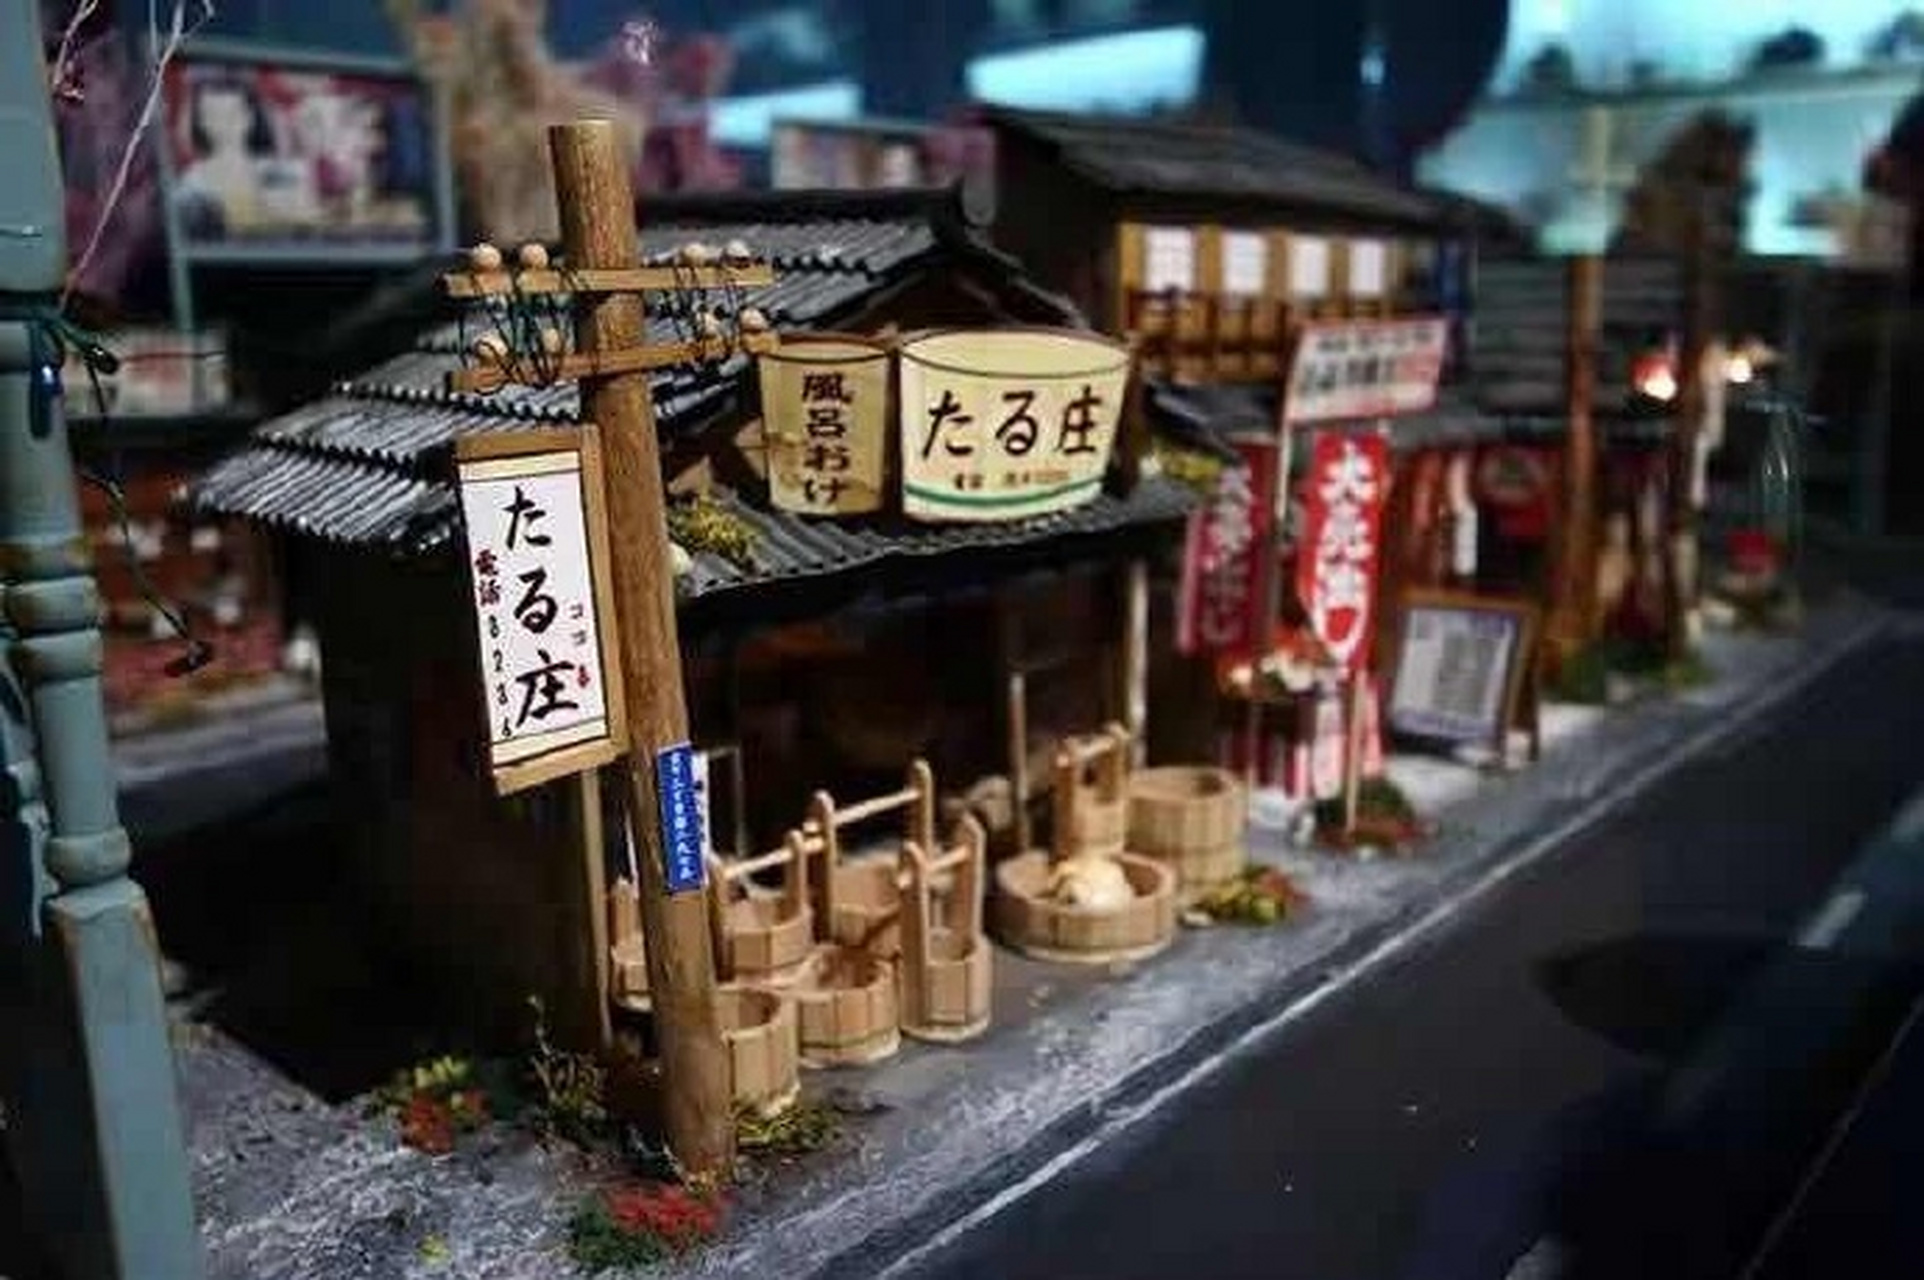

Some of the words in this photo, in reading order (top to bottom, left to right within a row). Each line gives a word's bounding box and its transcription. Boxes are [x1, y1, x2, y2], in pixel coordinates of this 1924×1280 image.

[803, 373, 854, 504] 風呂おけ
[922, 386, 1104, 460] たる庄
[501, 485, 580, 730] たる庄
